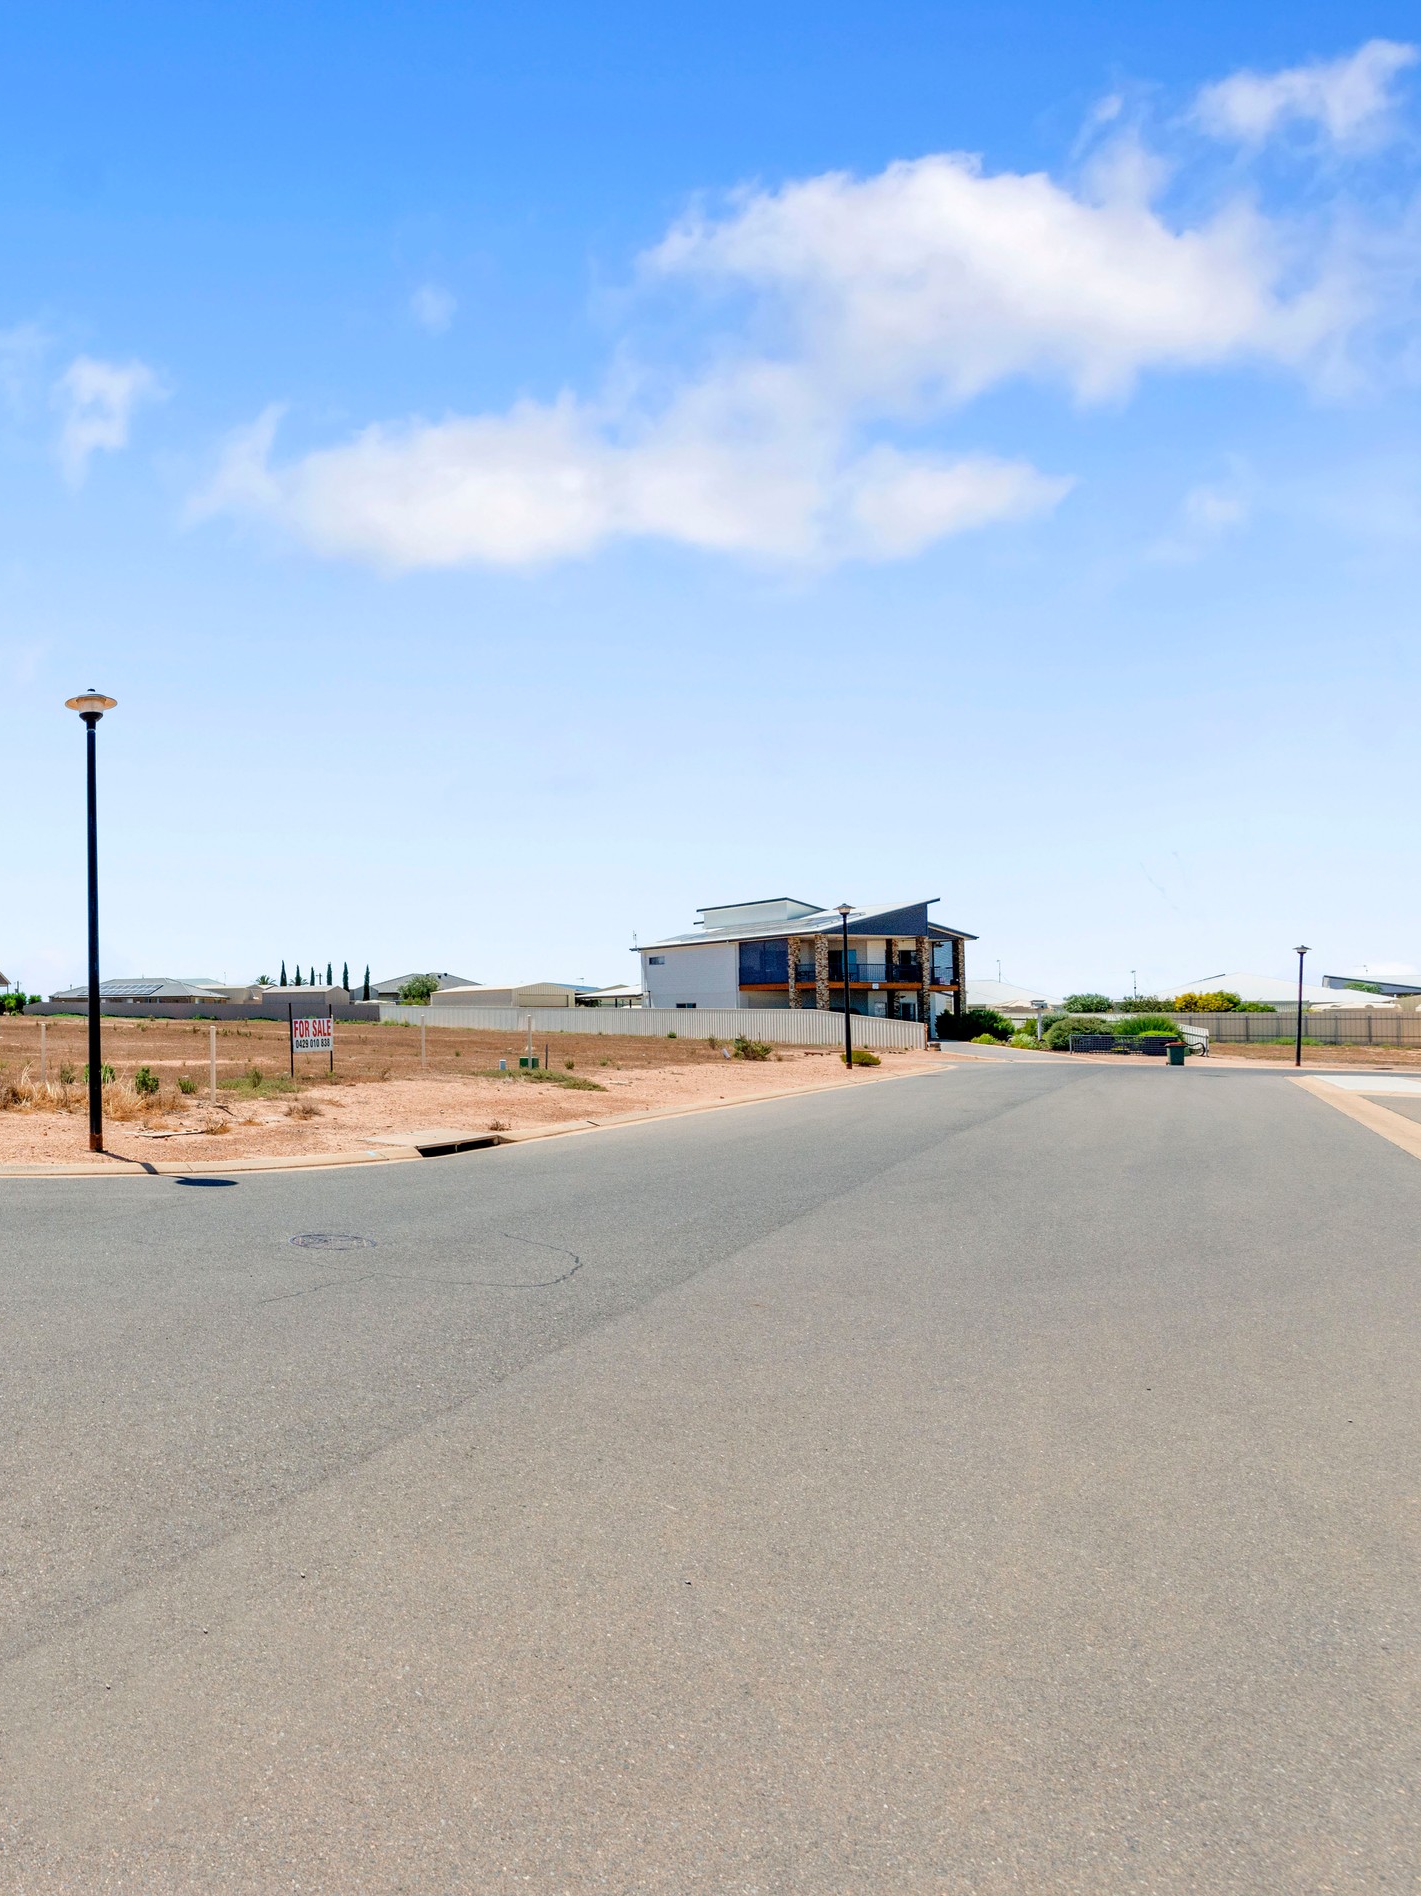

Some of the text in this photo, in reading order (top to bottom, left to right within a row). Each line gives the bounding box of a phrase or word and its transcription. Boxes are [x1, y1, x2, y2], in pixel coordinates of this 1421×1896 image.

[294, 1019, 331, 1038] FOR SALE
[296, 1038, 330, 1049] 0429 010 838
